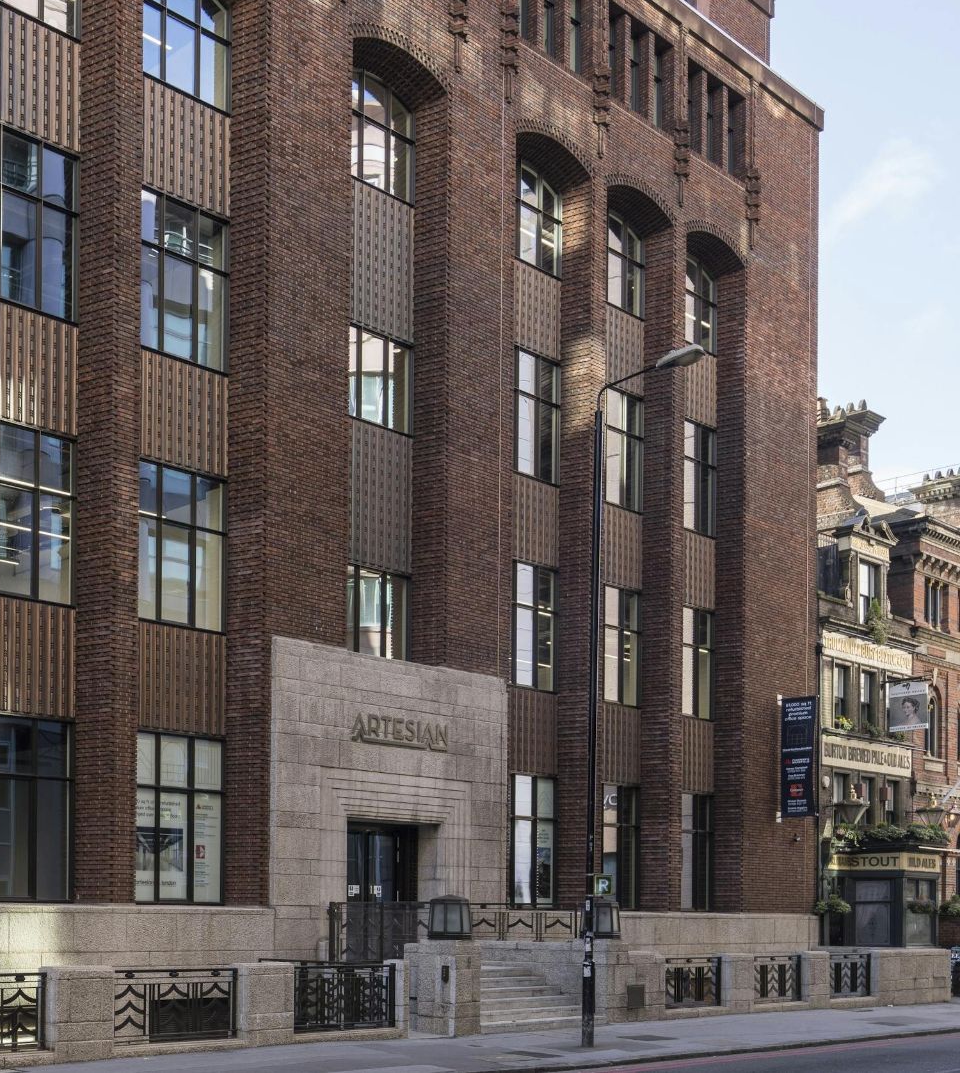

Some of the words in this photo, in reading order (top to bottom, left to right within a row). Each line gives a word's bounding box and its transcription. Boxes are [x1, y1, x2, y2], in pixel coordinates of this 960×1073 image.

[351, 711, 448, 750] ARTESIAN
[823, 742, 847, 761] BURTON
[848, 746, 871, 764] BREWED
[871, 749, 884, 766] PALE
[897, 754, 910, 769] ALES
[851, 856, 900, 867] STOUT
[598, 878, 609, 892] R
